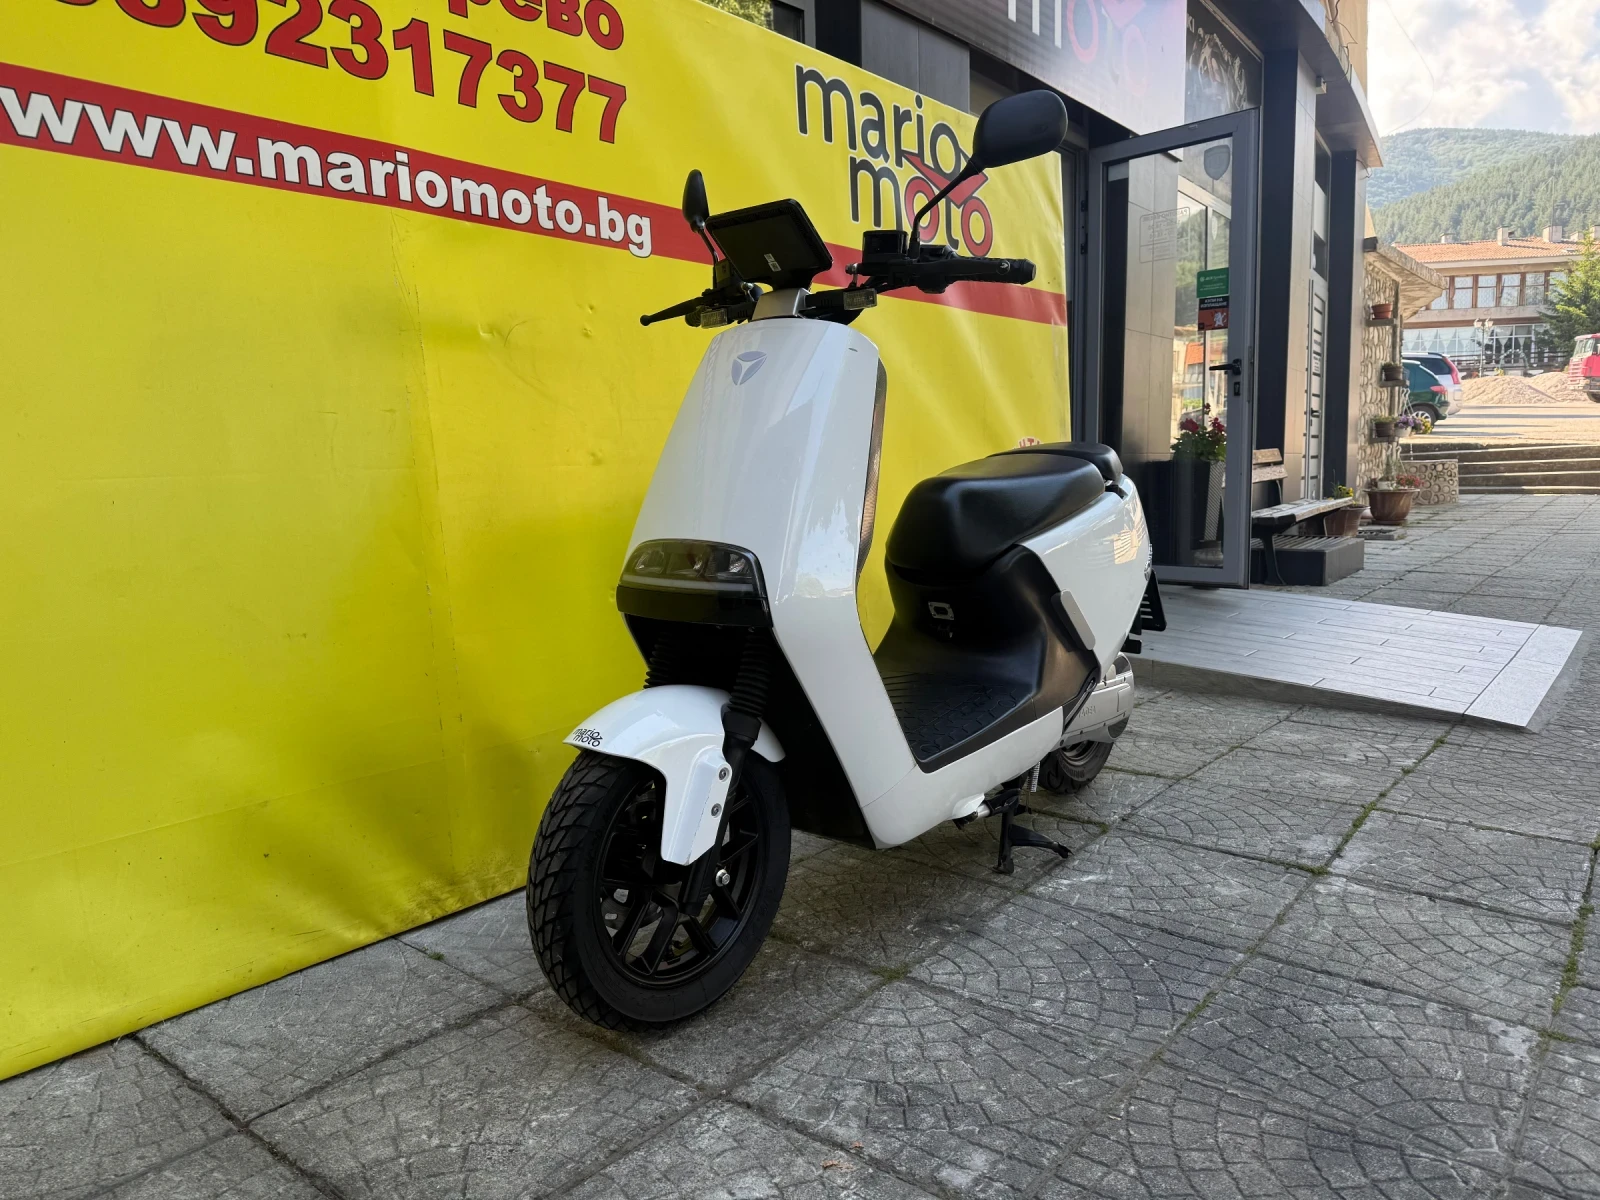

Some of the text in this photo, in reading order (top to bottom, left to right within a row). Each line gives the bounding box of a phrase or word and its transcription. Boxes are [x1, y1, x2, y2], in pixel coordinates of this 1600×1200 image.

[56, 0, 627, 144] 92317377
[448, 0, 624, 50] ево
[0, 86, 652, 258] www.mariomoto.bg
[795, 64, 962, 182] mario
[849, 155, 994, 257] moto
[573, 728, 601, 738] mario
[573, 734, 601, 747] moto
